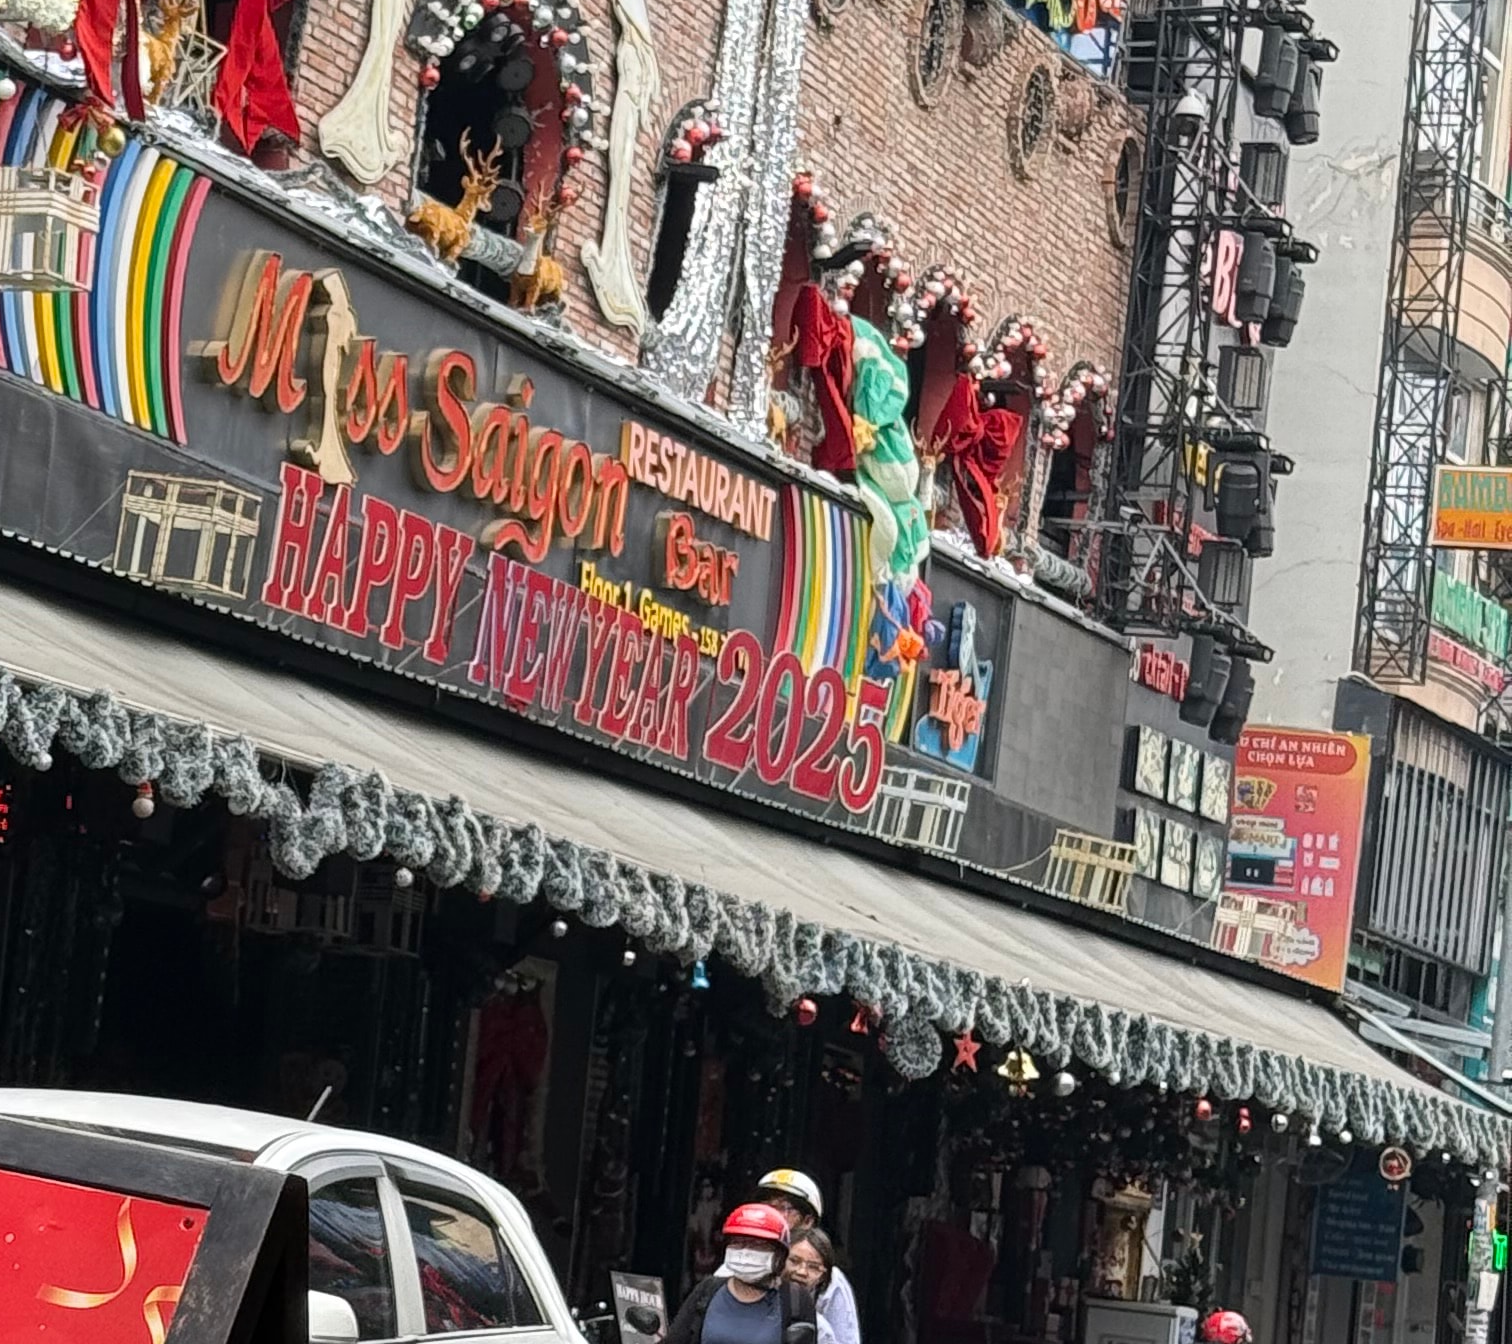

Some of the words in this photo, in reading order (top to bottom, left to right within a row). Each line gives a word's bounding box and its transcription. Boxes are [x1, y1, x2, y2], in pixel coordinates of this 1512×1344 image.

[422, 348, 626, 562] Saigon
[626, 422, 778, 540] RESTAURANT
[665, 511, 742, 606] Bar
[260, 462, 475, 663] HAPPY
[469, 552, 589, 712] NEW
[574, 592, 700, 760] YEAR
[702, 628, 891, 814] 2025
[928, 668, 987, 752] Tiger
